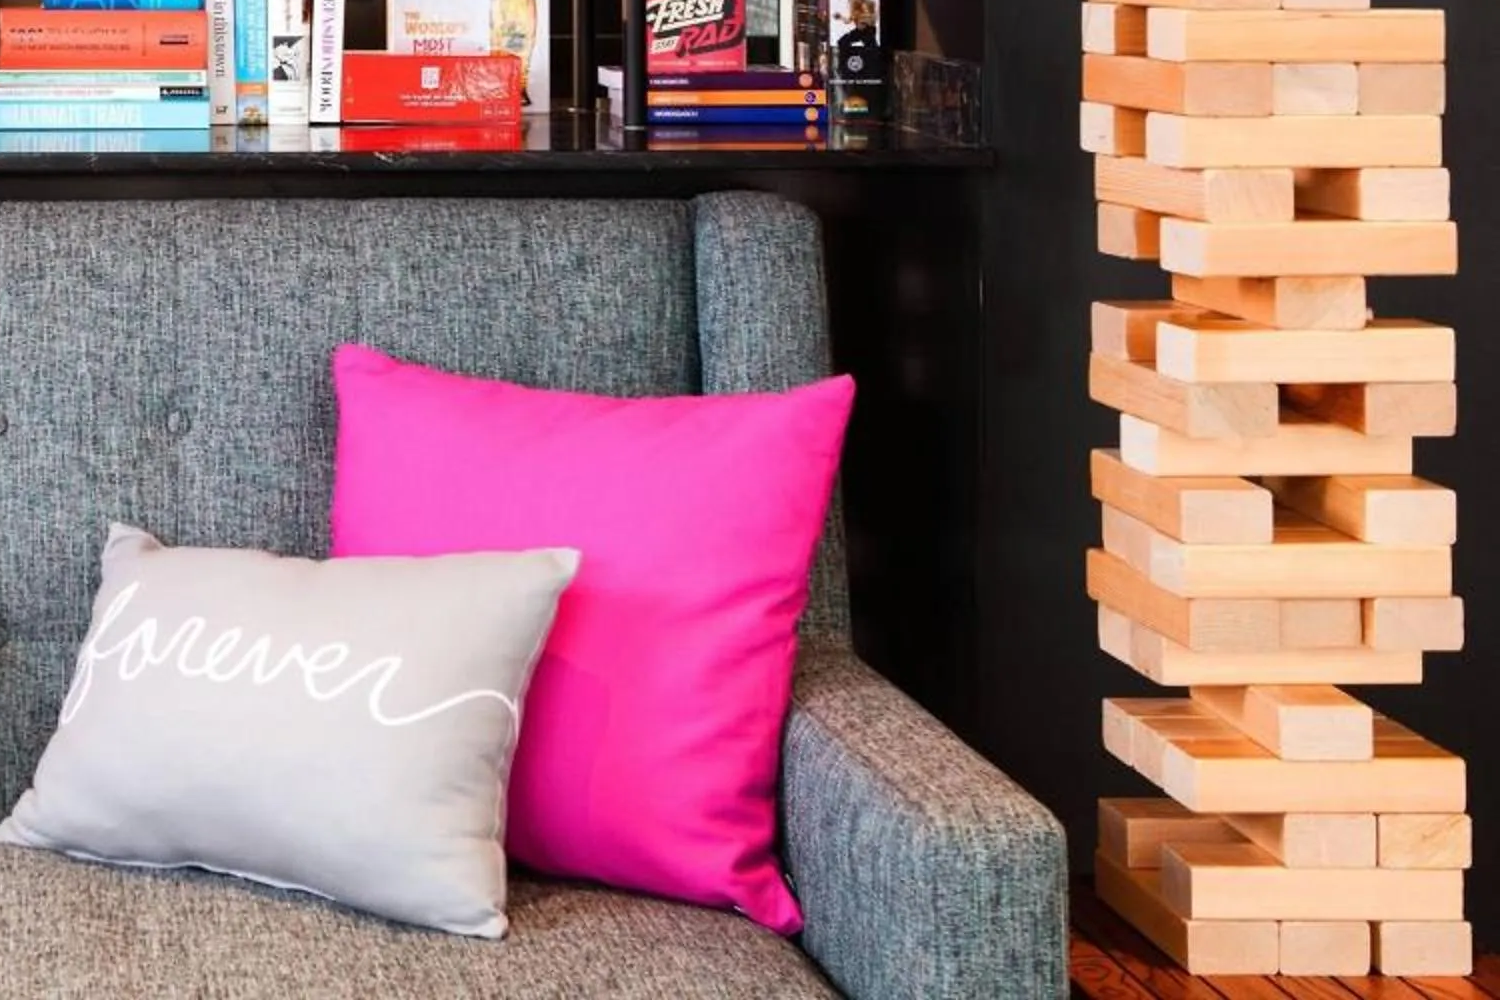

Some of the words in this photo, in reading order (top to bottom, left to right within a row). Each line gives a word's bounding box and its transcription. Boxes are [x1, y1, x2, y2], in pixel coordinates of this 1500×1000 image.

[413, 38, 452, 53] MOST
[677, 22, 742, 56] RAD
[60, 582, 519, 736] forever
